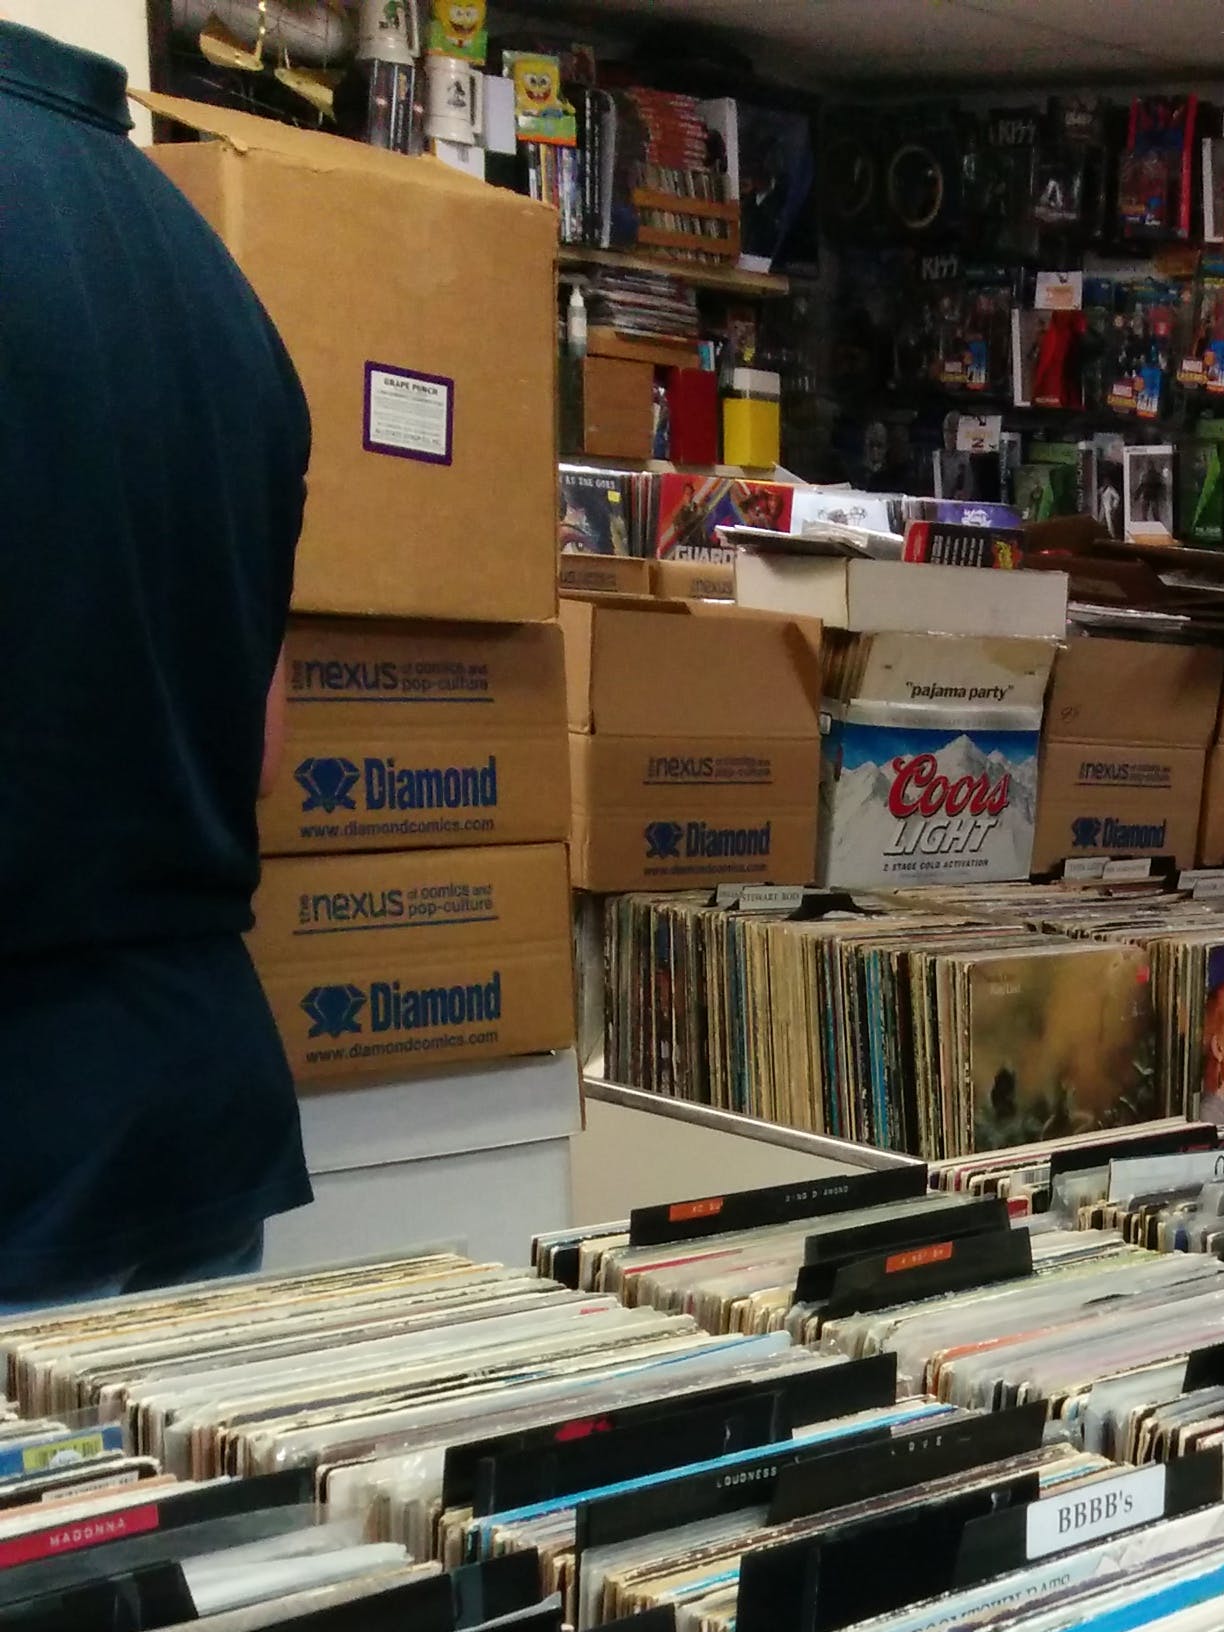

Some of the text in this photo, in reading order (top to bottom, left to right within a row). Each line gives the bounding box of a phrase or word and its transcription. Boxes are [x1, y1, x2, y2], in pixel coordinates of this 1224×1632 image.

[305, 660, 398, 690] nexus
[364, 755, 498, 810] Diamond
[887, 753, 1012, 818] Coors
[300, 817, 495, 838] www.diamondcomics.com
[685, 820, 772, 857] Diamond
[883, 818, 998, 857] LIGHT
[311, 889, 404, 922] nexus
[408, 898, 493, 918] pop-culture
[370, 970, 502, 1033] Diamond
[305, 1030, 499, 1062] www.diamondcomics.com
[812, 1185, 849, 1199] DAMOND
[716, 1466, 777, 1488] LOUDNESS
[1057, 1489, 1134, 1534] BBBB's
[49, 1517, 127, 1547] MADONNA
